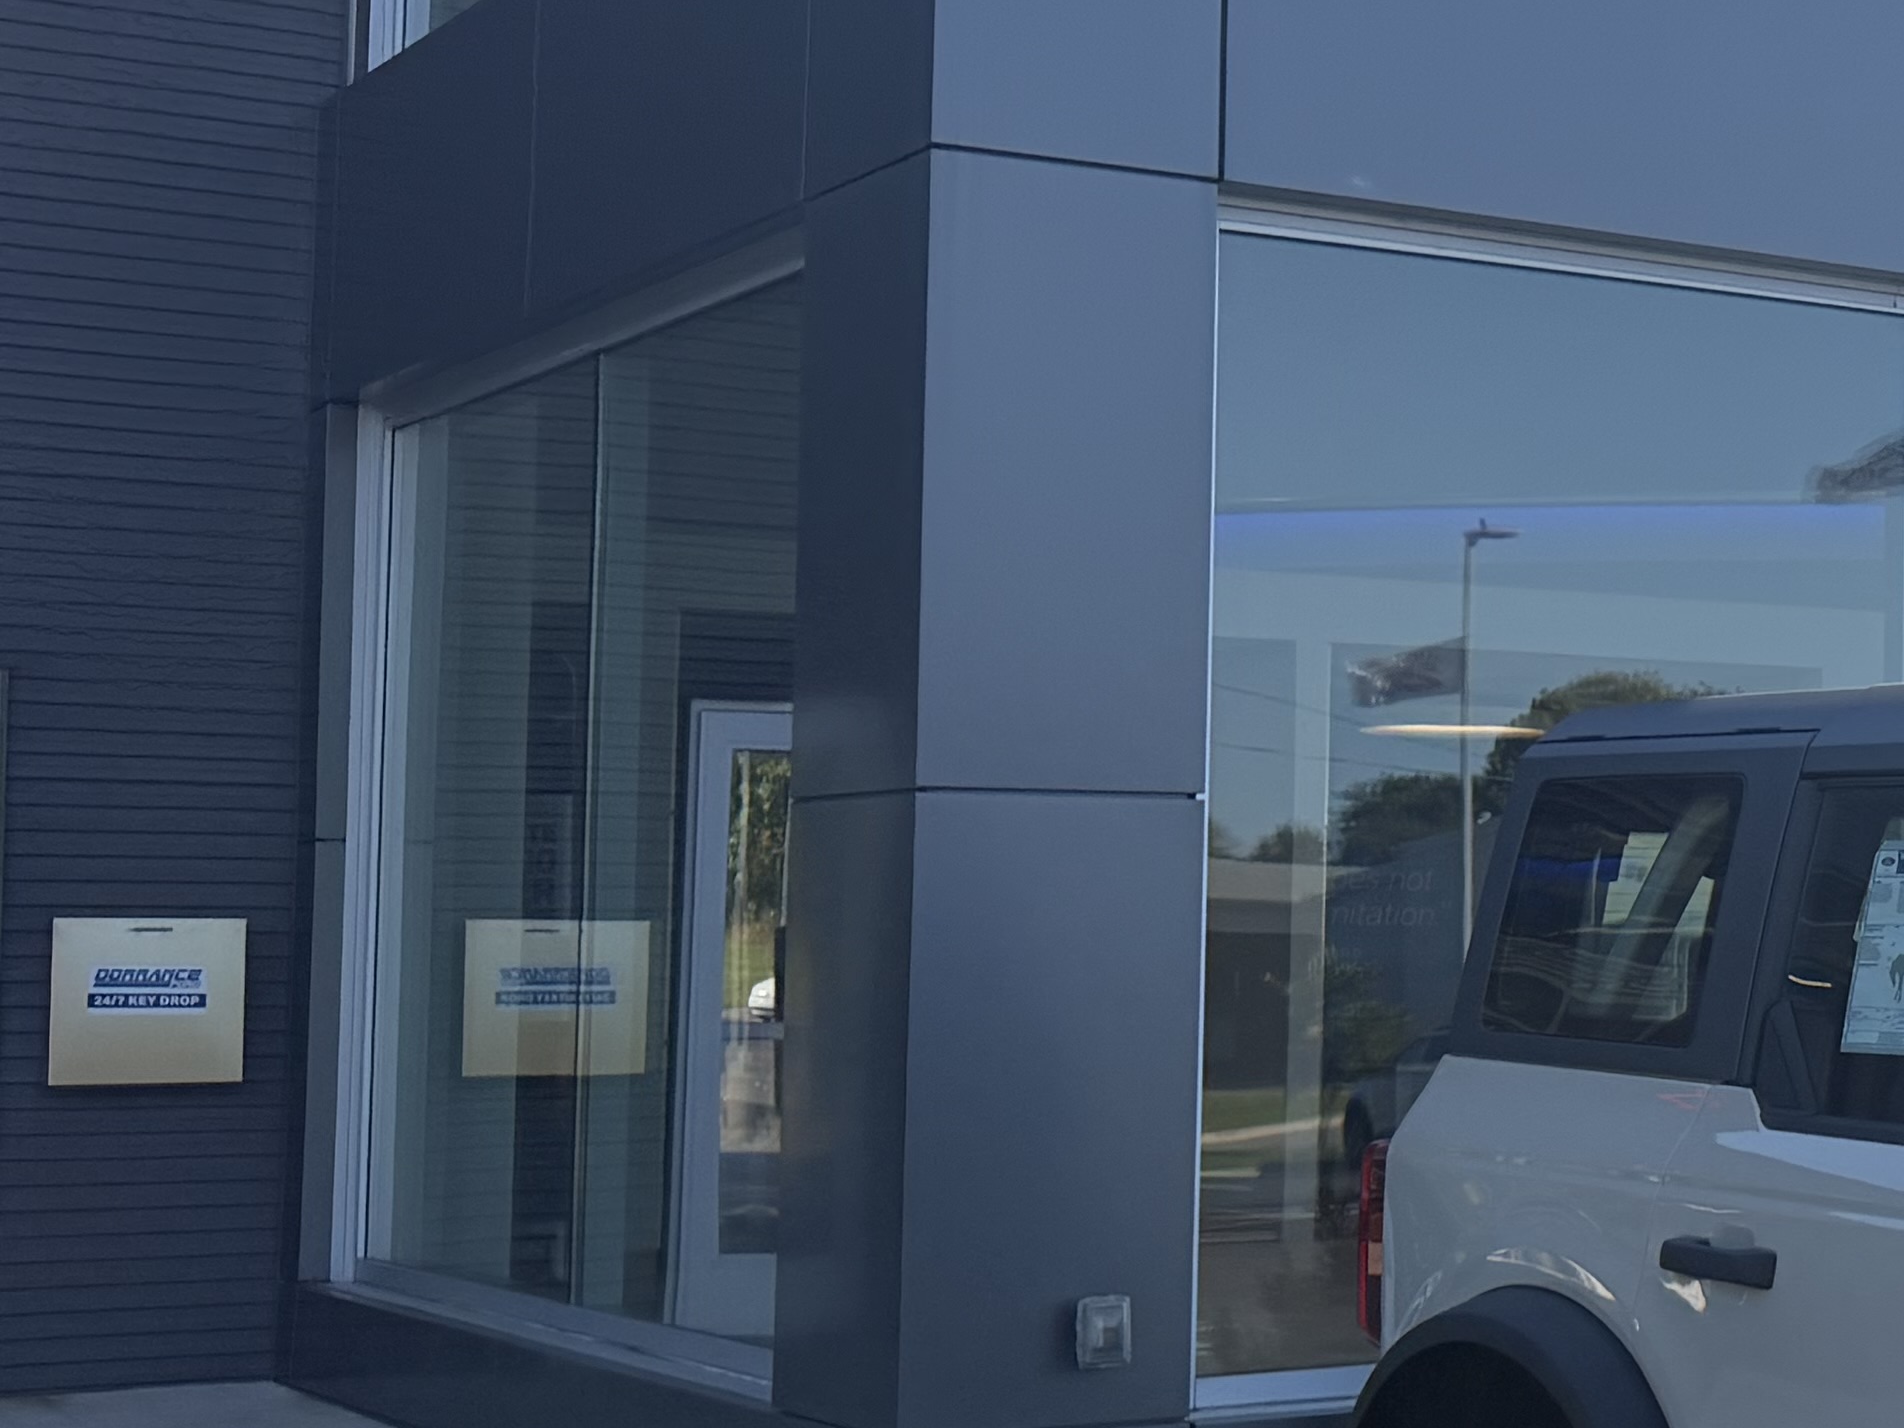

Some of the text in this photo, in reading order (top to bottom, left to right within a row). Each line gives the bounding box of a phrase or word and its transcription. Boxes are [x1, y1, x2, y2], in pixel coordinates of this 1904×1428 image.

[94, 995, 200, 1006] 24/7 KEY DROP
